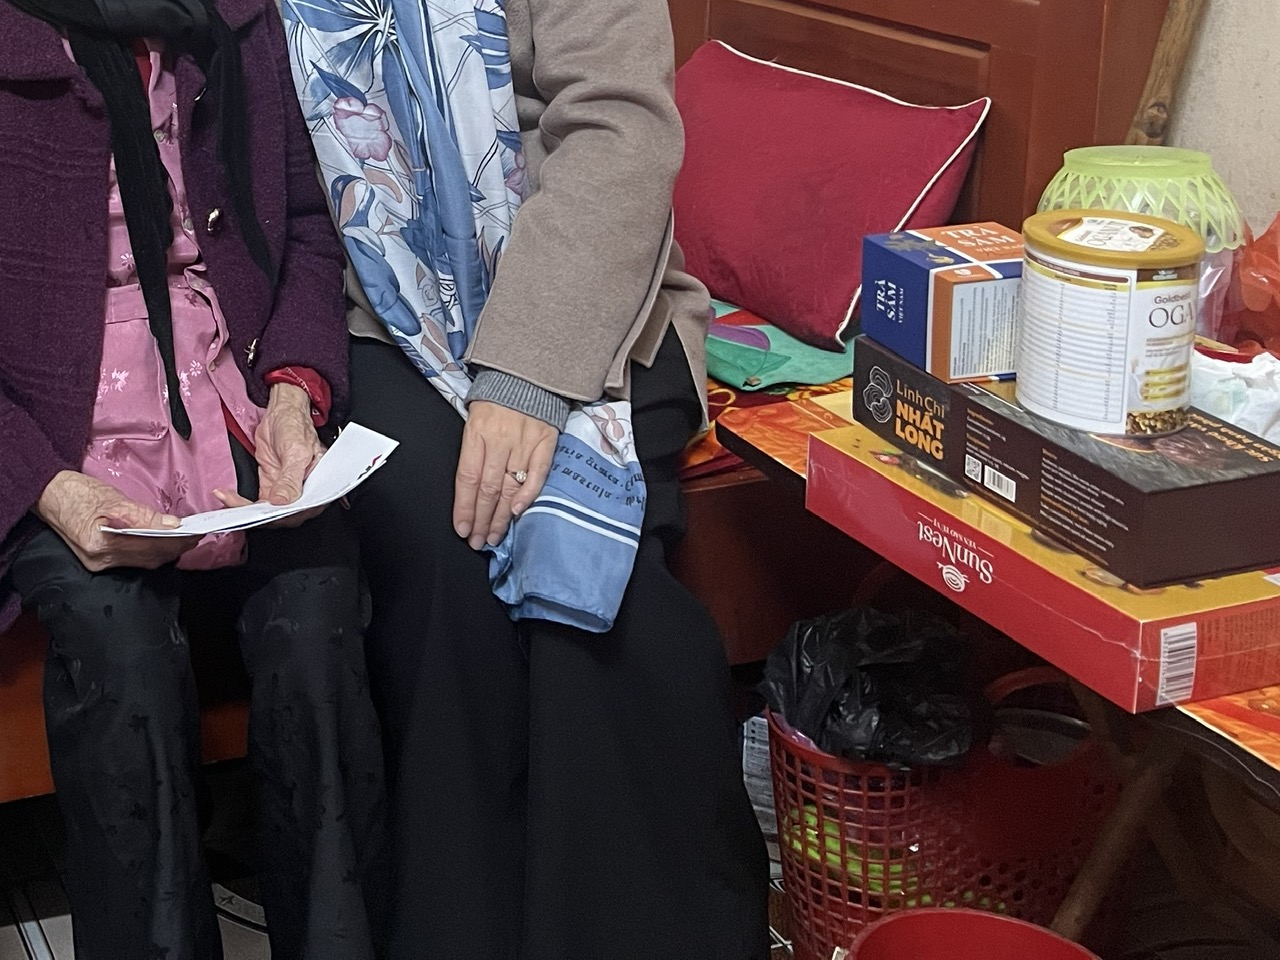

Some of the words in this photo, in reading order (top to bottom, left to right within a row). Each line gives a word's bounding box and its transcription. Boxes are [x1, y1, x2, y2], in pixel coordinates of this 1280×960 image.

[874, 279, 886, 311] TRÀ
[1148, 301, 1194, 329] OGA
[895, 417, 944, 460] LONG
[916, 520, 994, 585] SunNest
